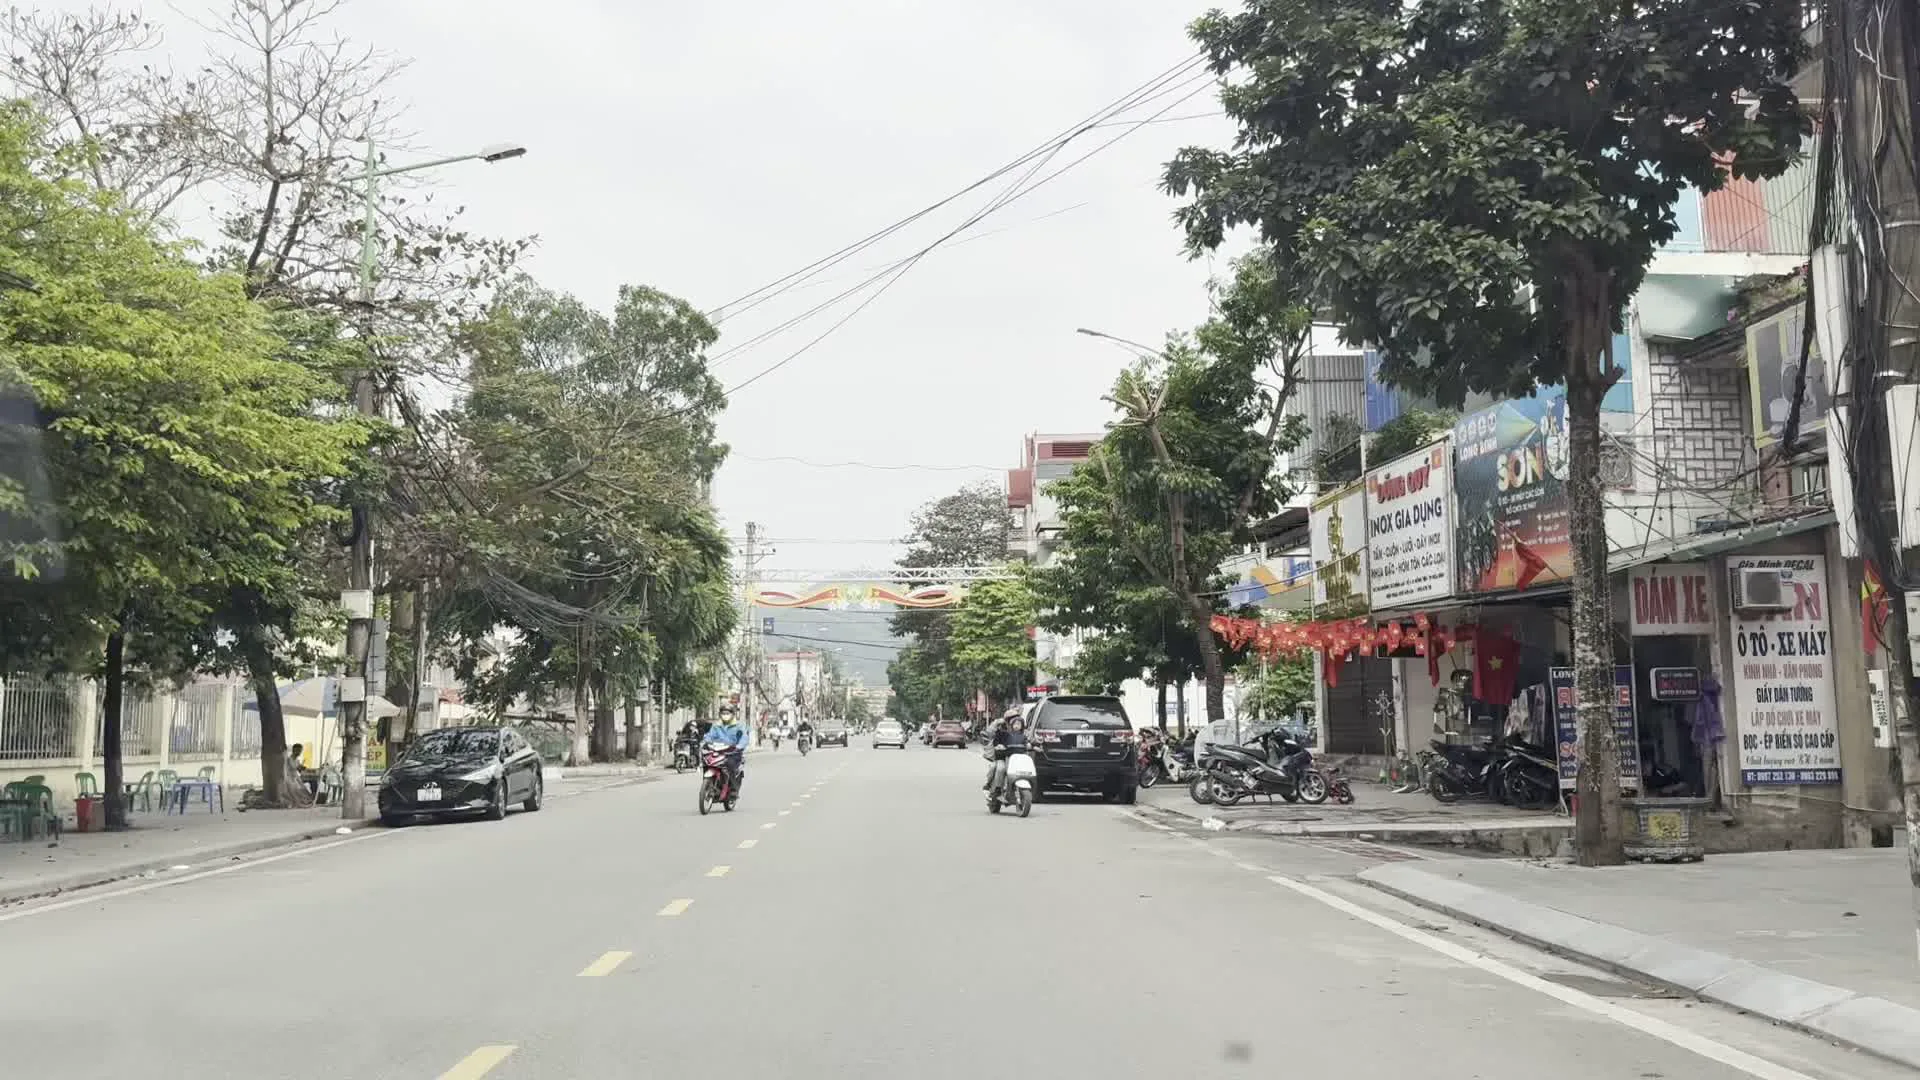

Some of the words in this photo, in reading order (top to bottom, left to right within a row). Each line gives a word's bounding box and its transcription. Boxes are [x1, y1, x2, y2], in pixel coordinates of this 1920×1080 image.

[1370, 512, 1394, 538] INOX
[1395, 508, 1412, 530] GIA
[1413, 497, 1443, 528] DỤNG
[1783, 560, 1815, 570] DECAL
[1634, 567, 1678, 624] DÁN
[1681, 575, 1711, 624] XE
[1737, 624, 1748, 656] Ô
[1749, 624, 1769, 656] TÔ
[1777, 631, 1797, 656] XE
[1797, 623, 1827, 656] MÁY
[1743, 661, 1761, 680] KÍNH
[1756, 682, 1772, 703] GIẤY
[1793, 727, 1804, 749] SỐ
[1804, 733, 1819, 749] CAO
[1820, 727, 1835, 749] CẤP
